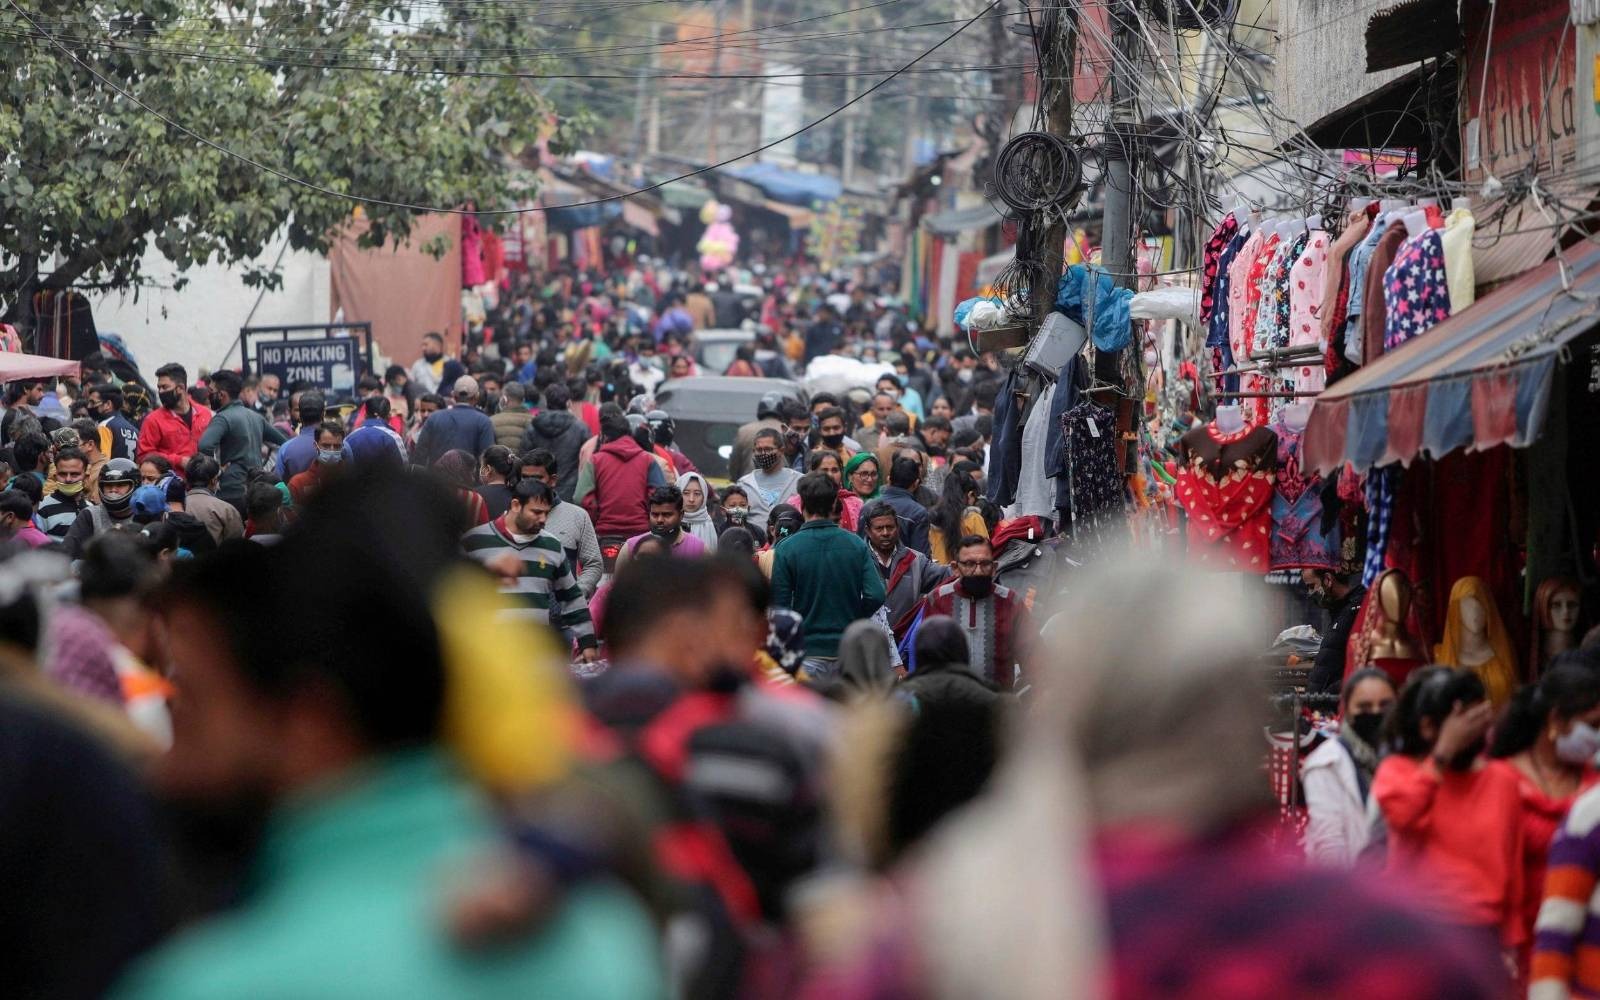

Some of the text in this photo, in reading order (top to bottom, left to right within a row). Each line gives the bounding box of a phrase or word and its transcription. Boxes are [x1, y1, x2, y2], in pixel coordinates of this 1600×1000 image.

[263, 345, 346, 364] NO PARKING
[286, 365, 325, 383] ZONE
[120, 427, 138, 440] USA
